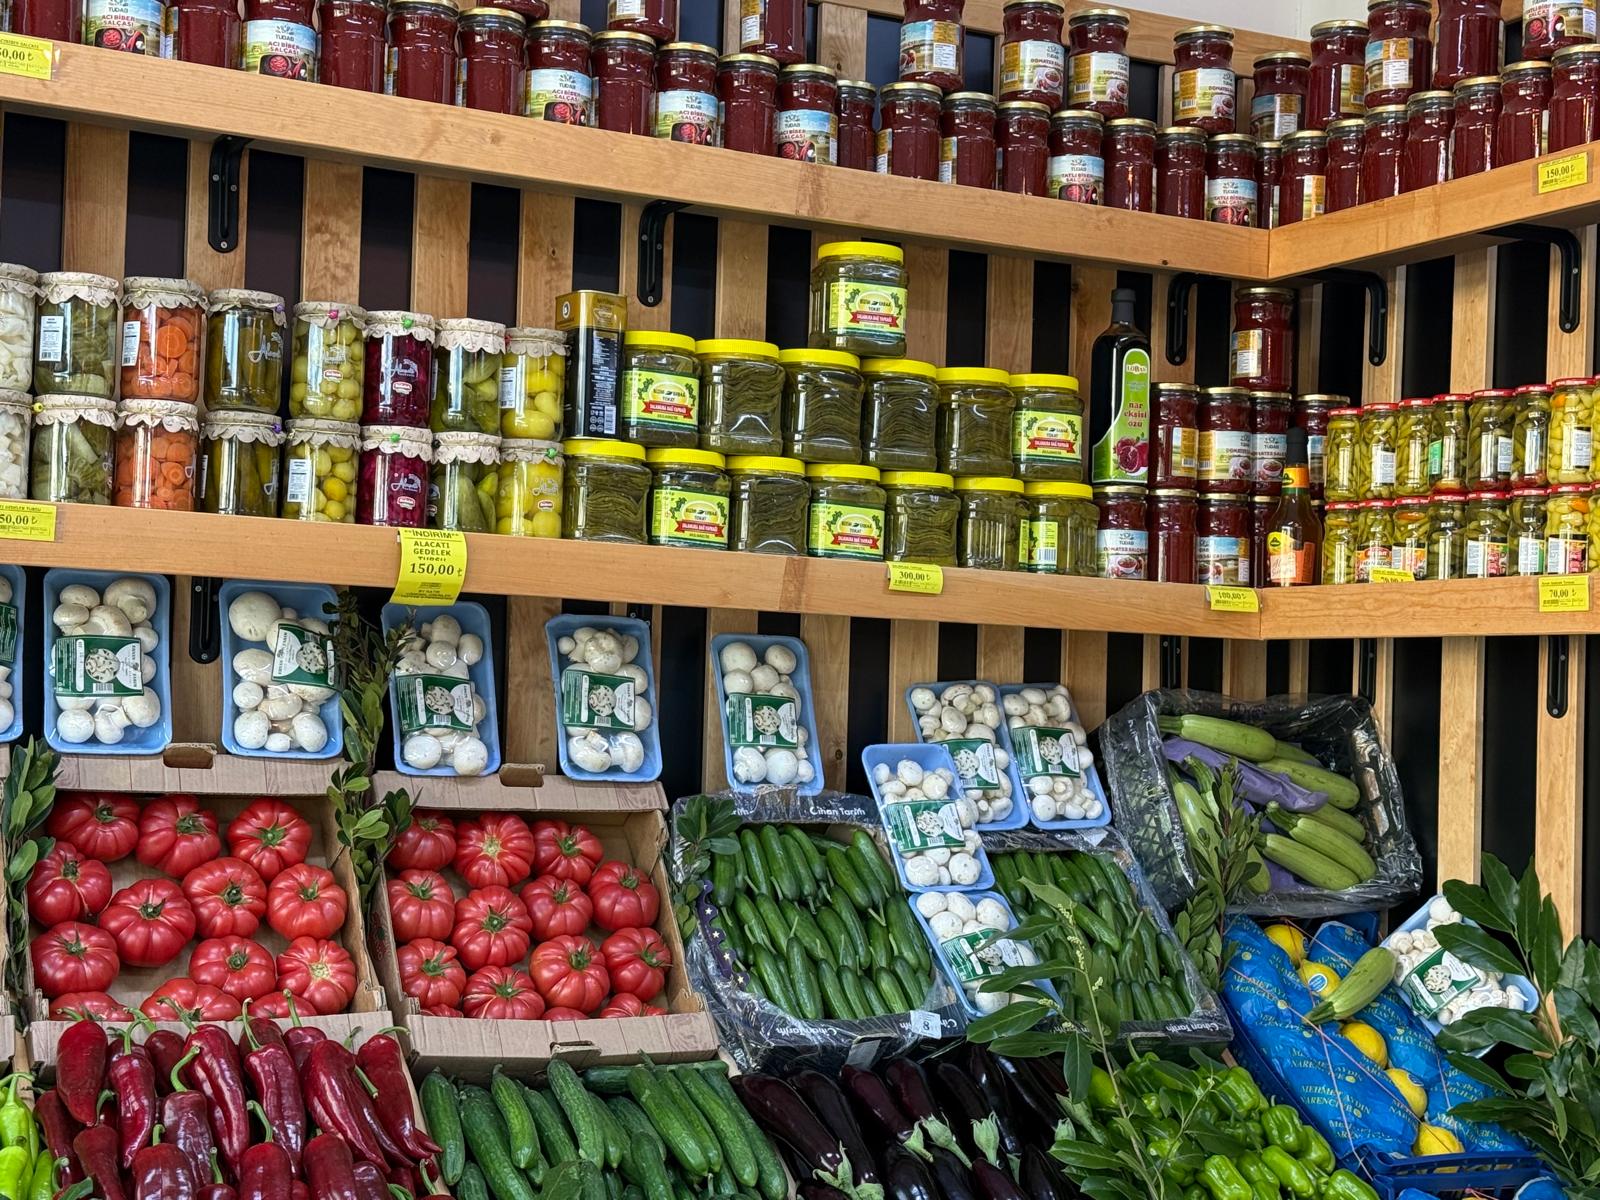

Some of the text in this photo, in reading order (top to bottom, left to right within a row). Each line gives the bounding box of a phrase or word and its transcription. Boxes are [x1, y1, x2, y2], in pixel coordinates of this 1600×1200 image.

[0, 48, 25, 61] 0,00
[1546, 165, 1570, 179] 150,00
[413, 540, 450, 549] ALACATI
[413, 548, 451, 557] GEDELEK
[409, 562, 455, 576] 150,00
[899, 571, 925, 581] 300,00
[1549, 588, 1569, 598] 70,00
[810, 806, 839, 816] Cihan
